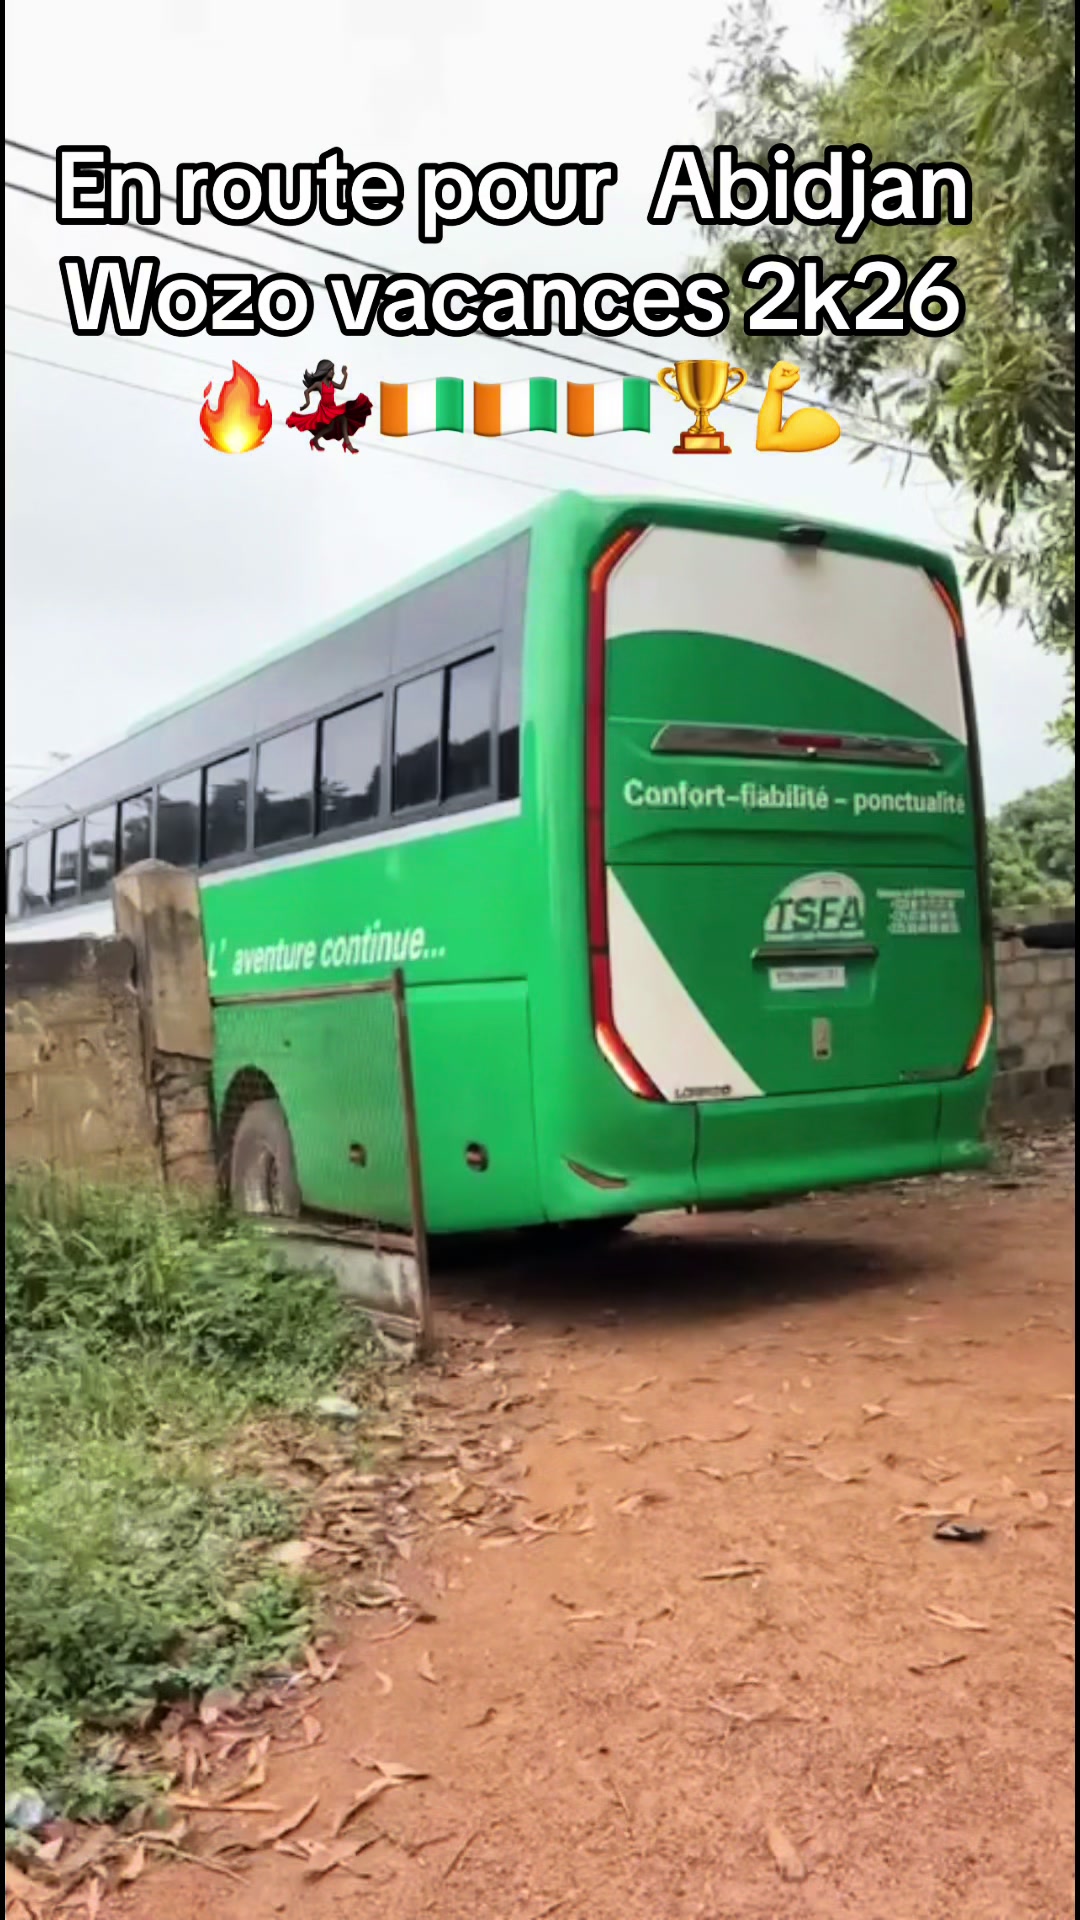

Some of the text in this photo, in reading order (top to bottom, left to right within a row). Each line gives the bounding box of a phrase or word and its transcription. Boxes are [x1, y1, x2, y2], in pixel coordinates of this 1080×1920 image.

[853, 789, 966, 816] ponctualité
[232, 937, 316, 976] aventure
[320, 918, 446, 968] continue...
